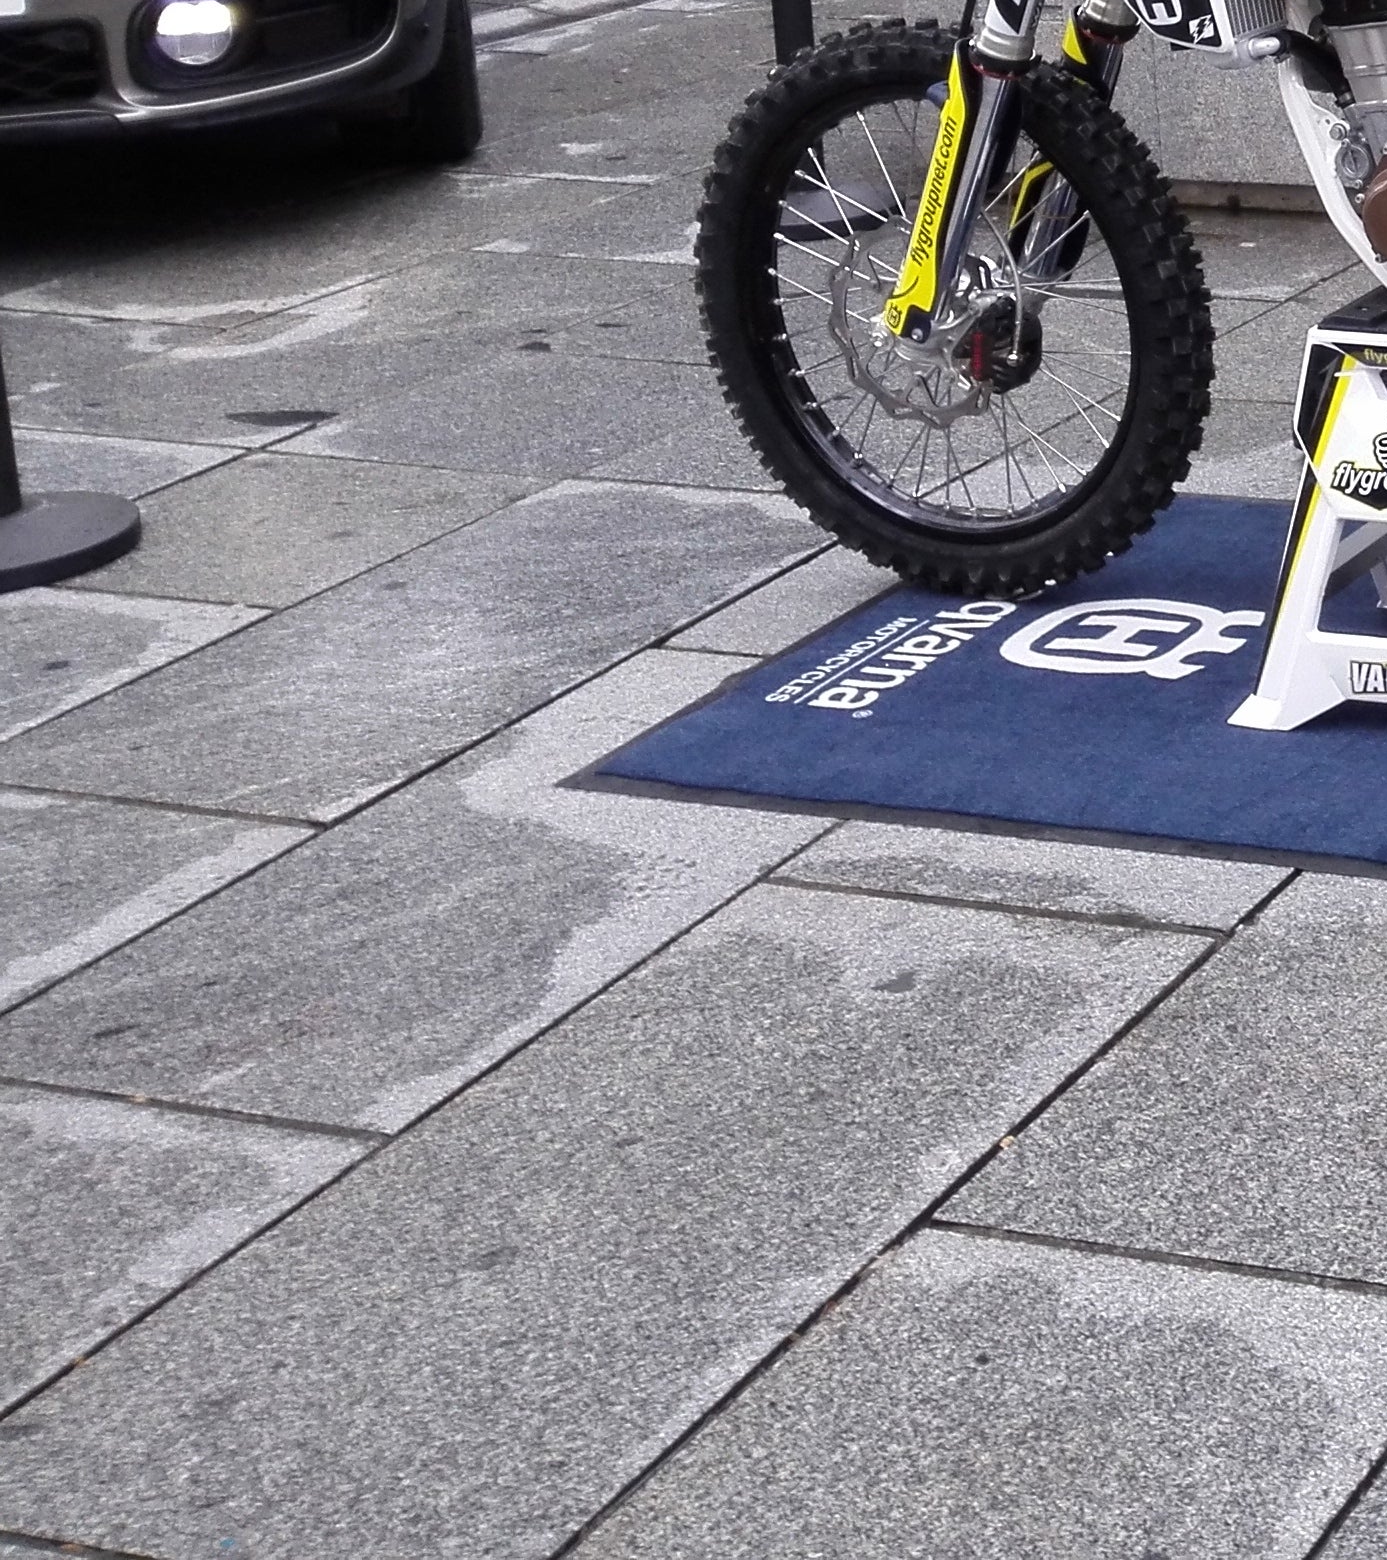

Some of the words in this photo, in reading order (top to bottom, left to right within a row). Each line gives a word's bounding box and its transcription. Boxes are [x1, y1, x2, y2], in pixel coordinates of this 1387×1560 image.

[910, 116, 958, 268] flygroupnet.com
[763, 616, 918, 704] MOTORCYCLES
[808, 600, 1017, 711] qvarna
